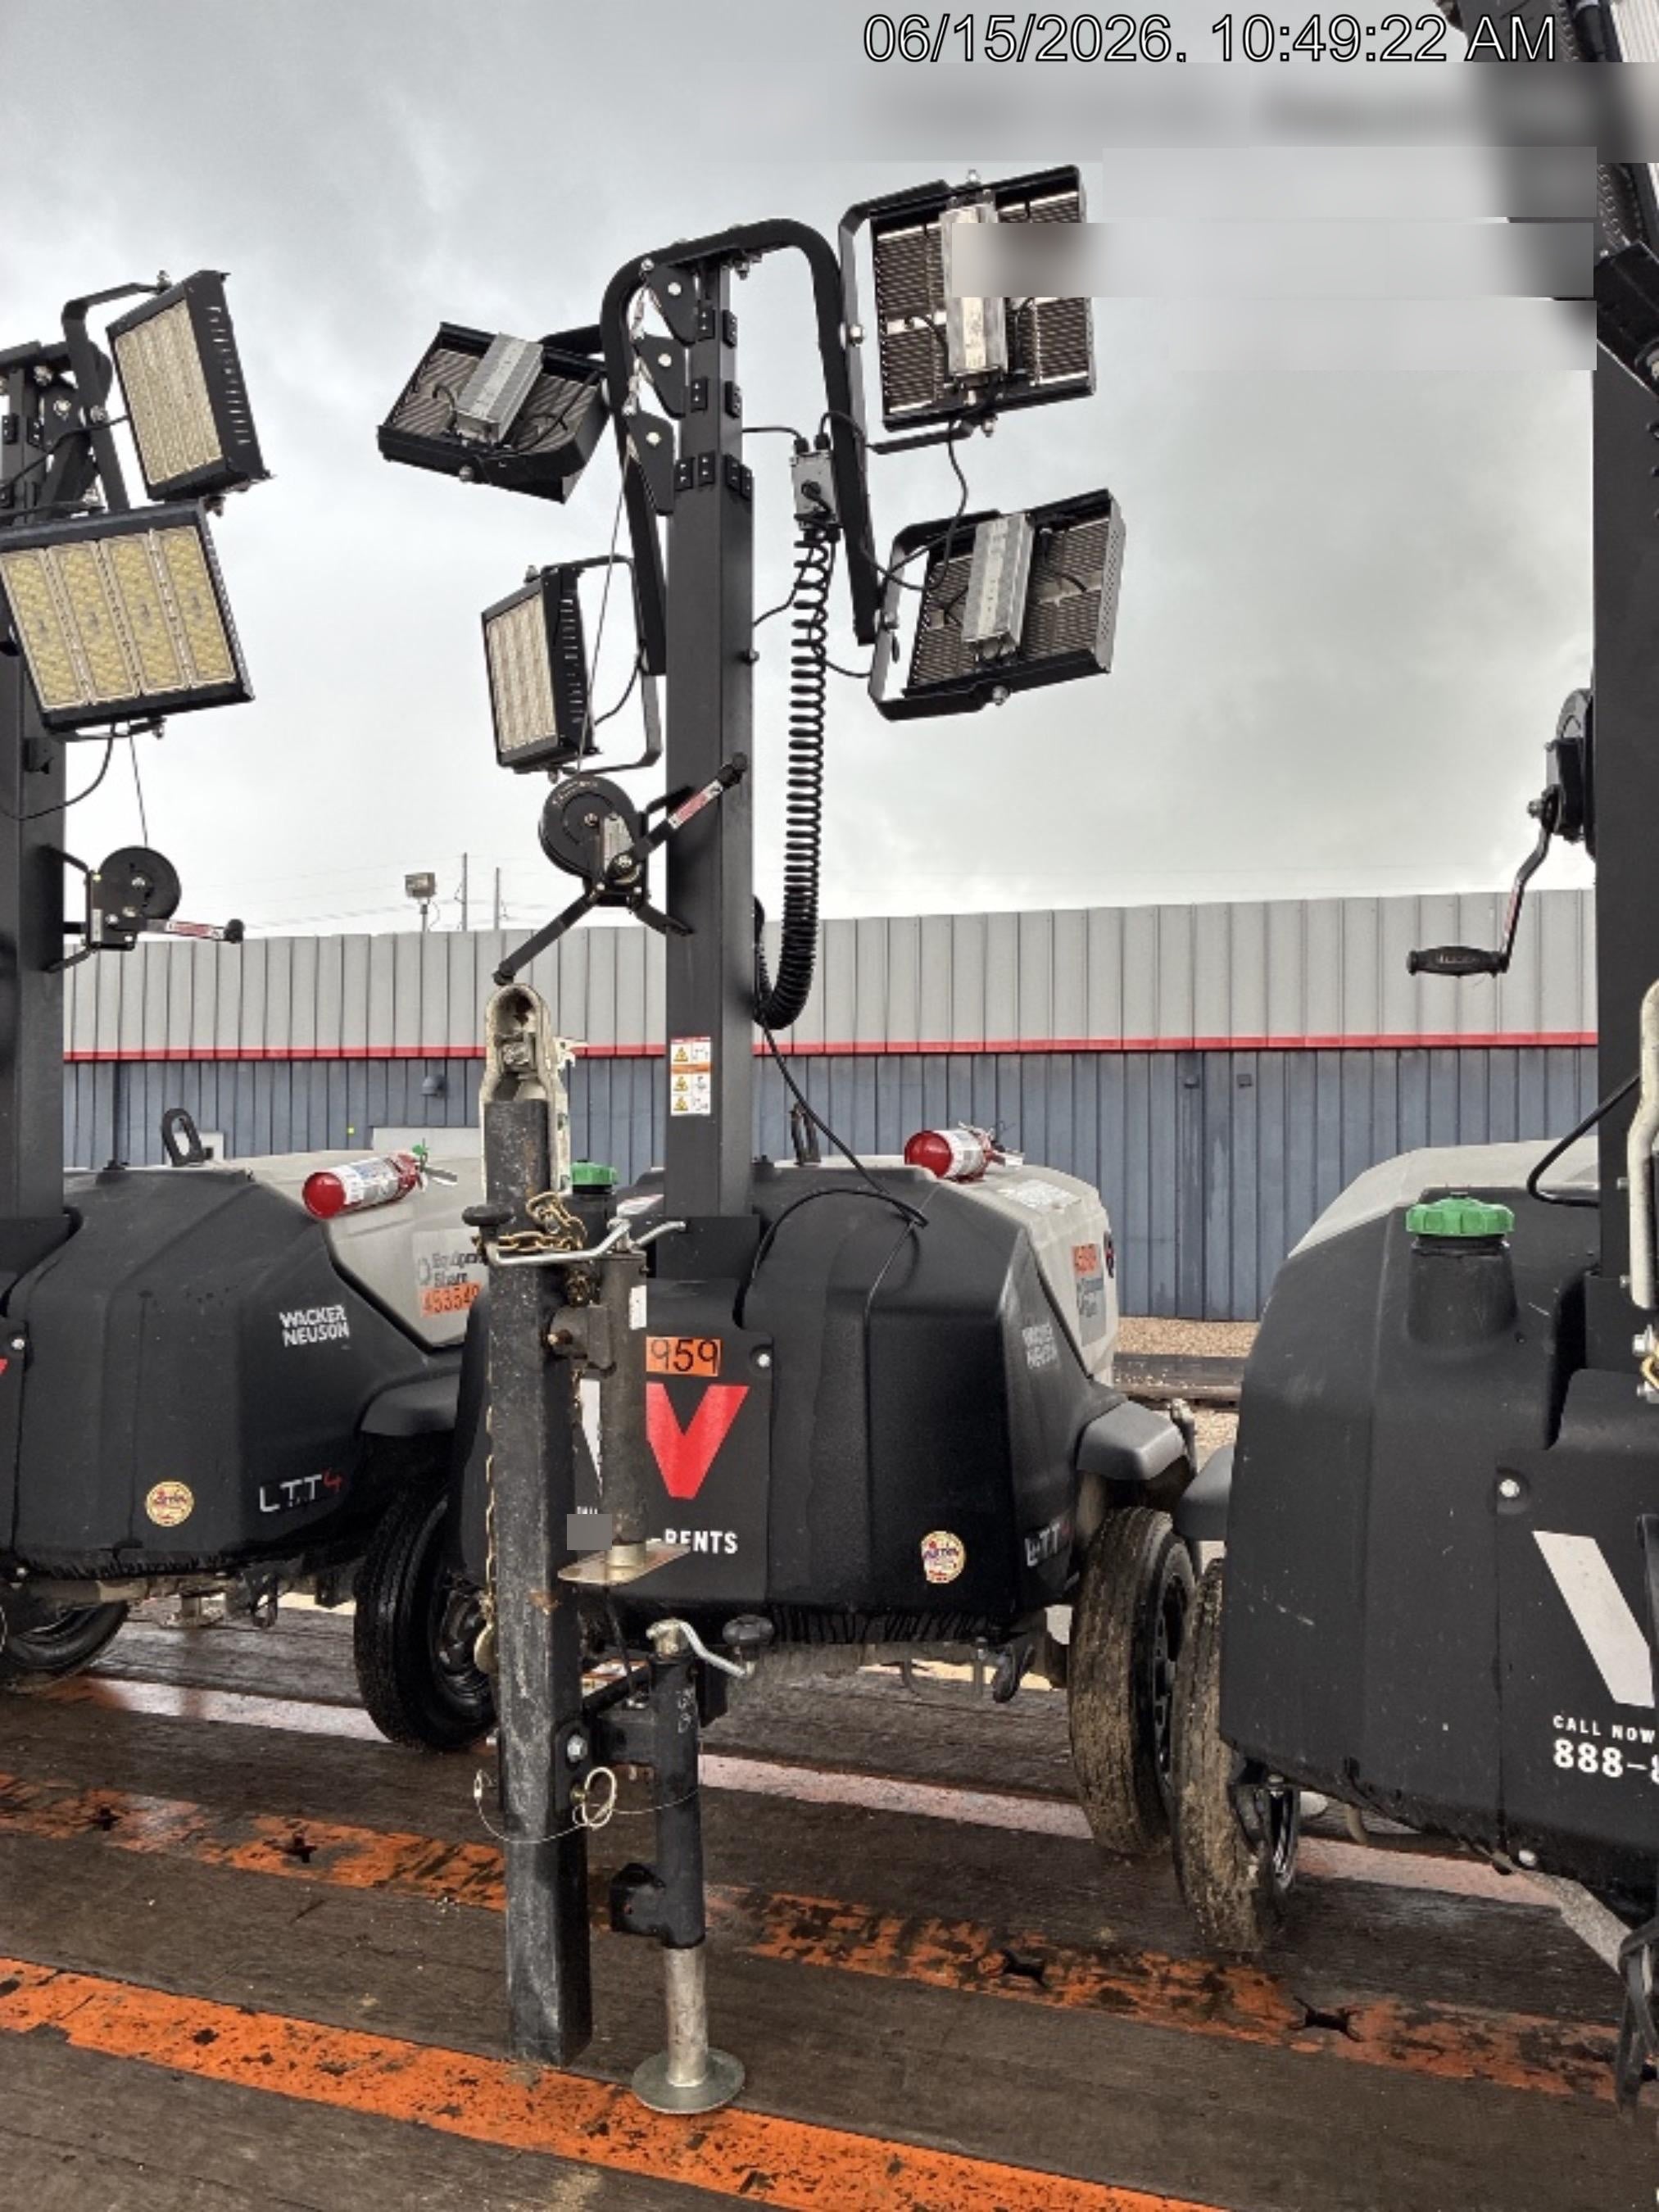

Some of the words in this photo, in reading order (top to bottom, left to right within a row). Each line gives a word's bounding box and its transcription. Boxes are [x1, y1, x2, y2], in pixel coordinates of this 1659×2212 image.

[279, 1304, 347, 1329] WACKER
[282, 1321, 350, 1348] NEUSON
[1552, 1714, 1602, 1737] CALL
[1611, 1724, 1657, 1744] NOW
